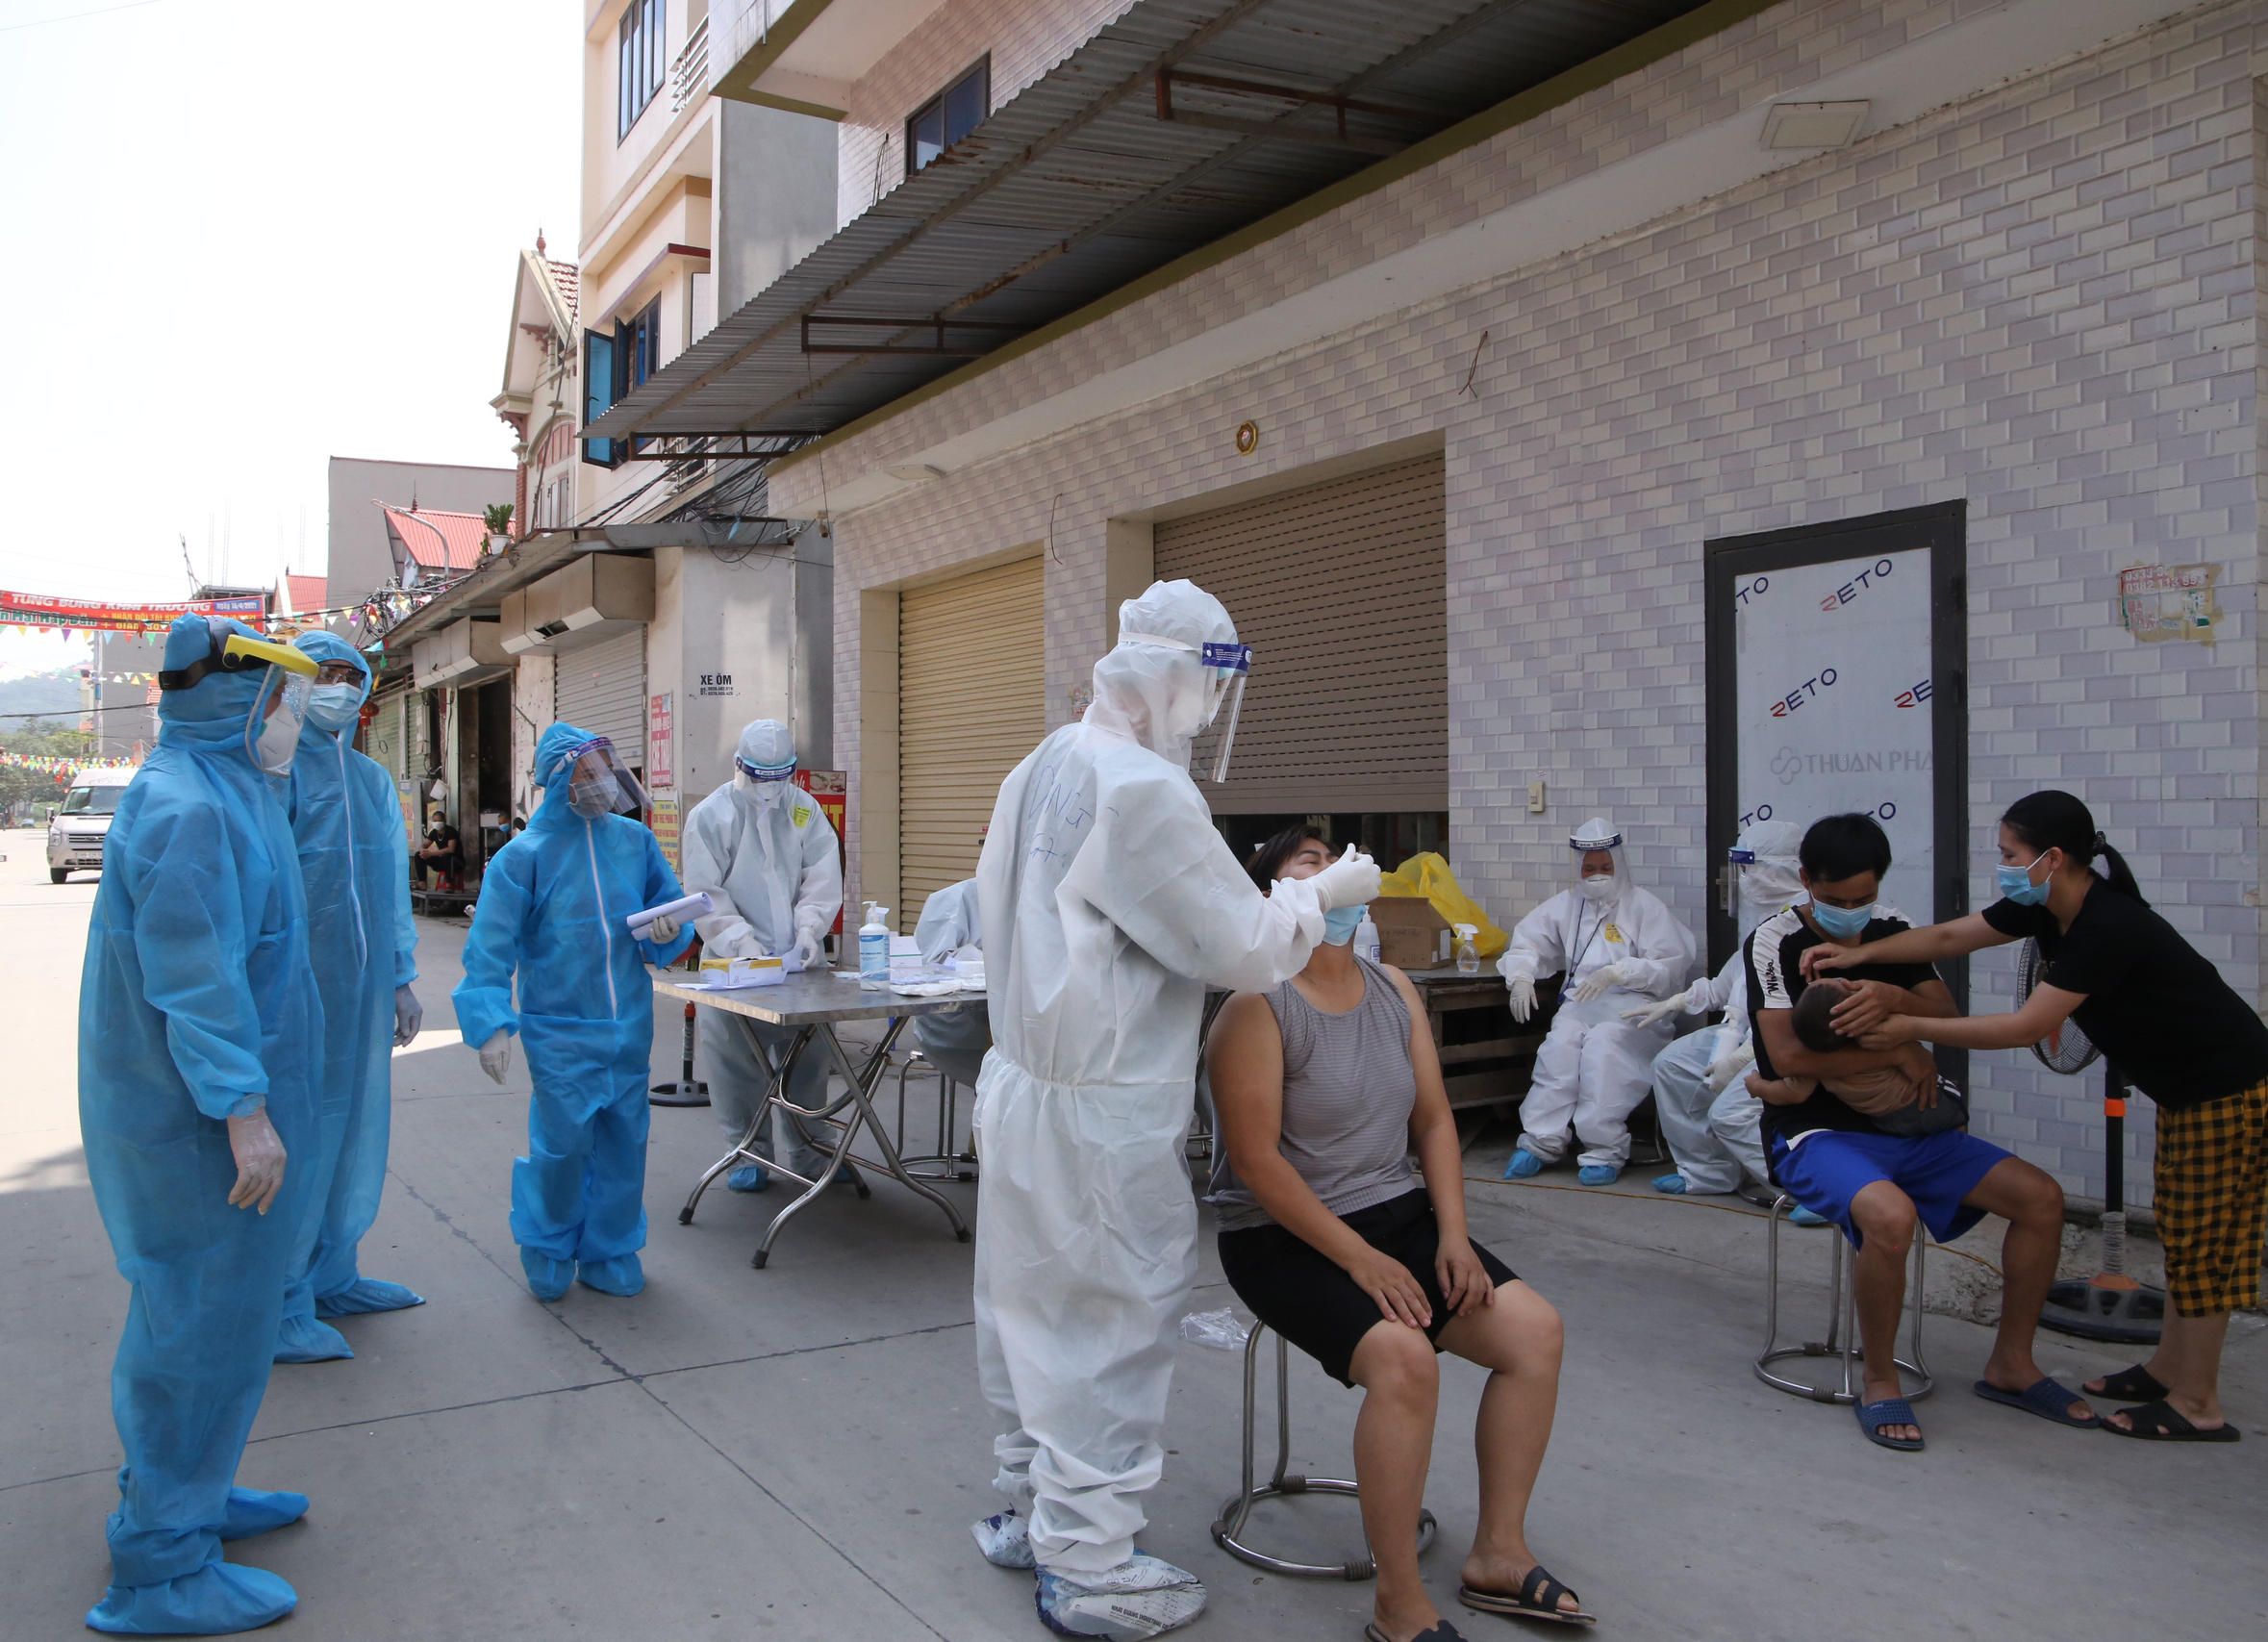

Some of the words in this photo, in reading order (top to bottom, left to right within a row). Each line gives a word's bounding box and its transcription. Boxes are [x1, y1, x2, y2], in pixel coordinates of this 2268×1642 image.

[1735, 577, 1769, 612] TO
[700, 674, 713, 685] XE
[716, 672, 732, 685] ÔM
